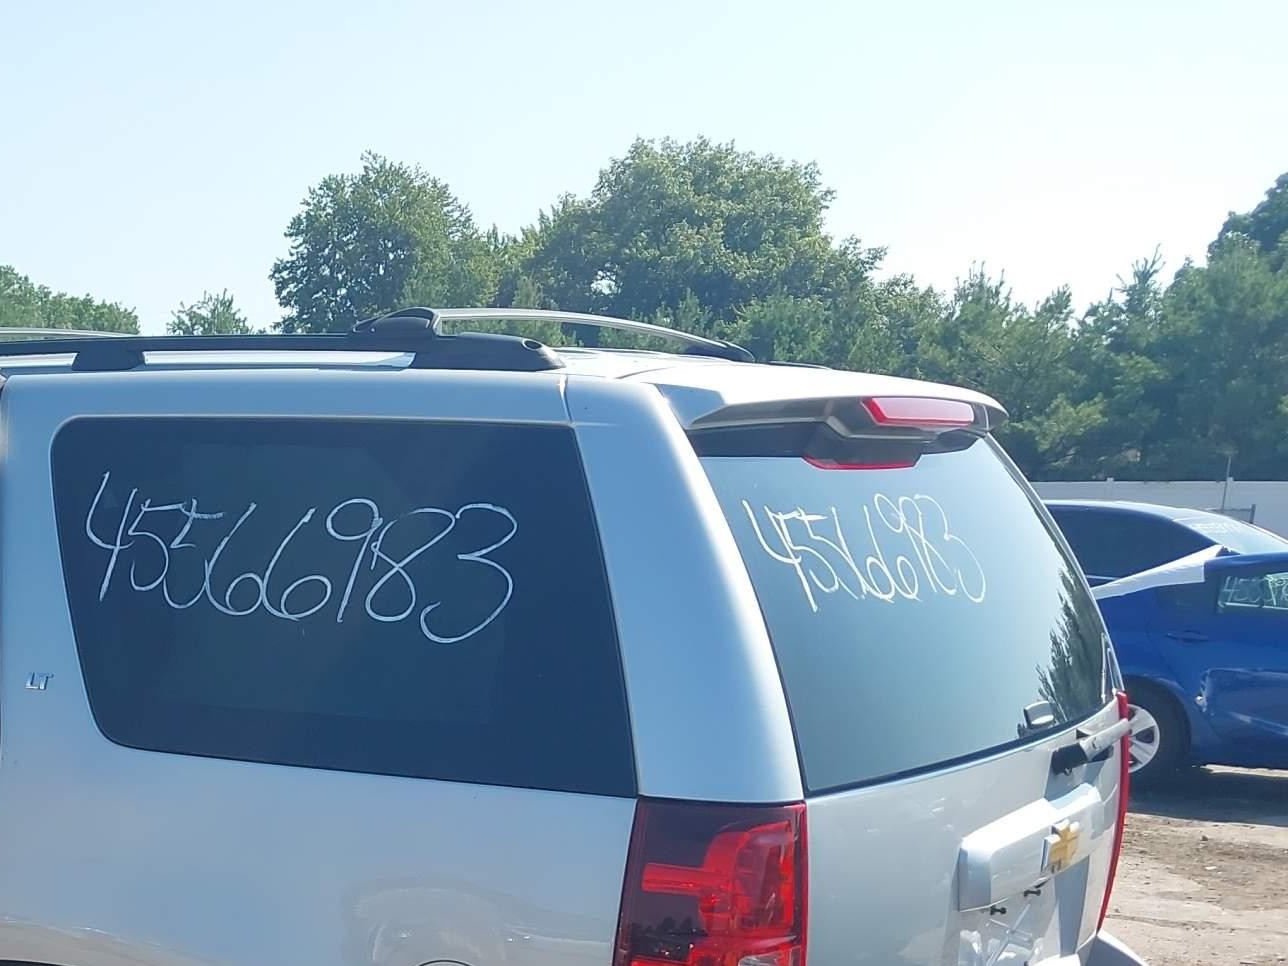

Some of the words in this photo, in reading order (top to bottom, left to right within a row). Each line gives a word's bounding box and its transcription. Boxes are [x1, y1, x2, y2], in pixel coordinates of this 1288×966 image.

[86, 471, 517, 643] 45566983
[742, 493, 987, 612] 45566983
[25, 671, 55, 690] LT
